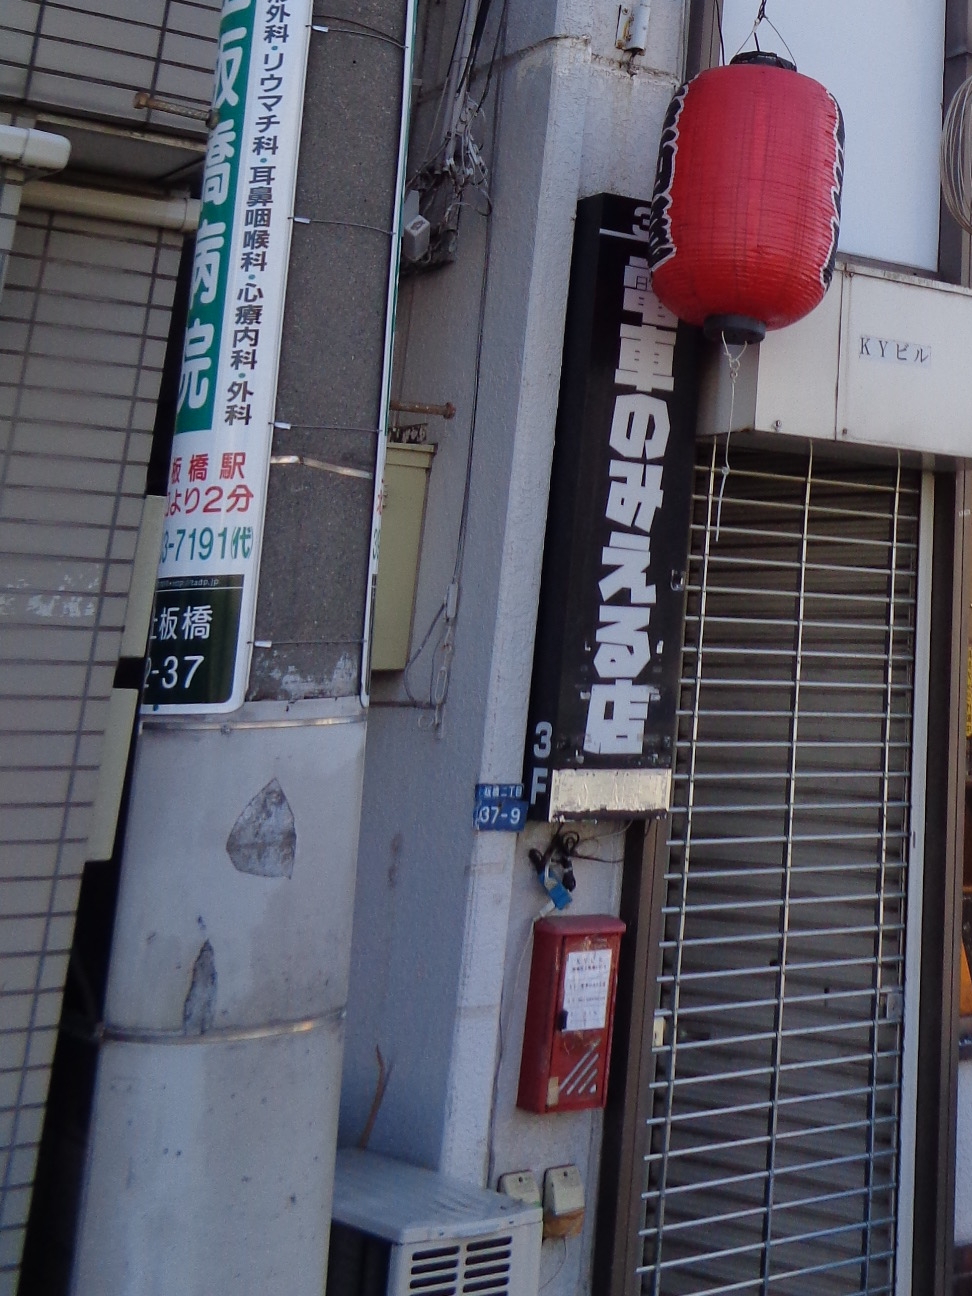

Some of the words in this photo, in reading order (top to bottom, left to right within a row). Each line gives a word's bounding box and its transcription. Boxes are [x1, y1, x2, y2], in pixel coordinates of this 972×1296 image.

[164, 484, 254, 516] より2分
[480, 806, 521, 824] 37-9
